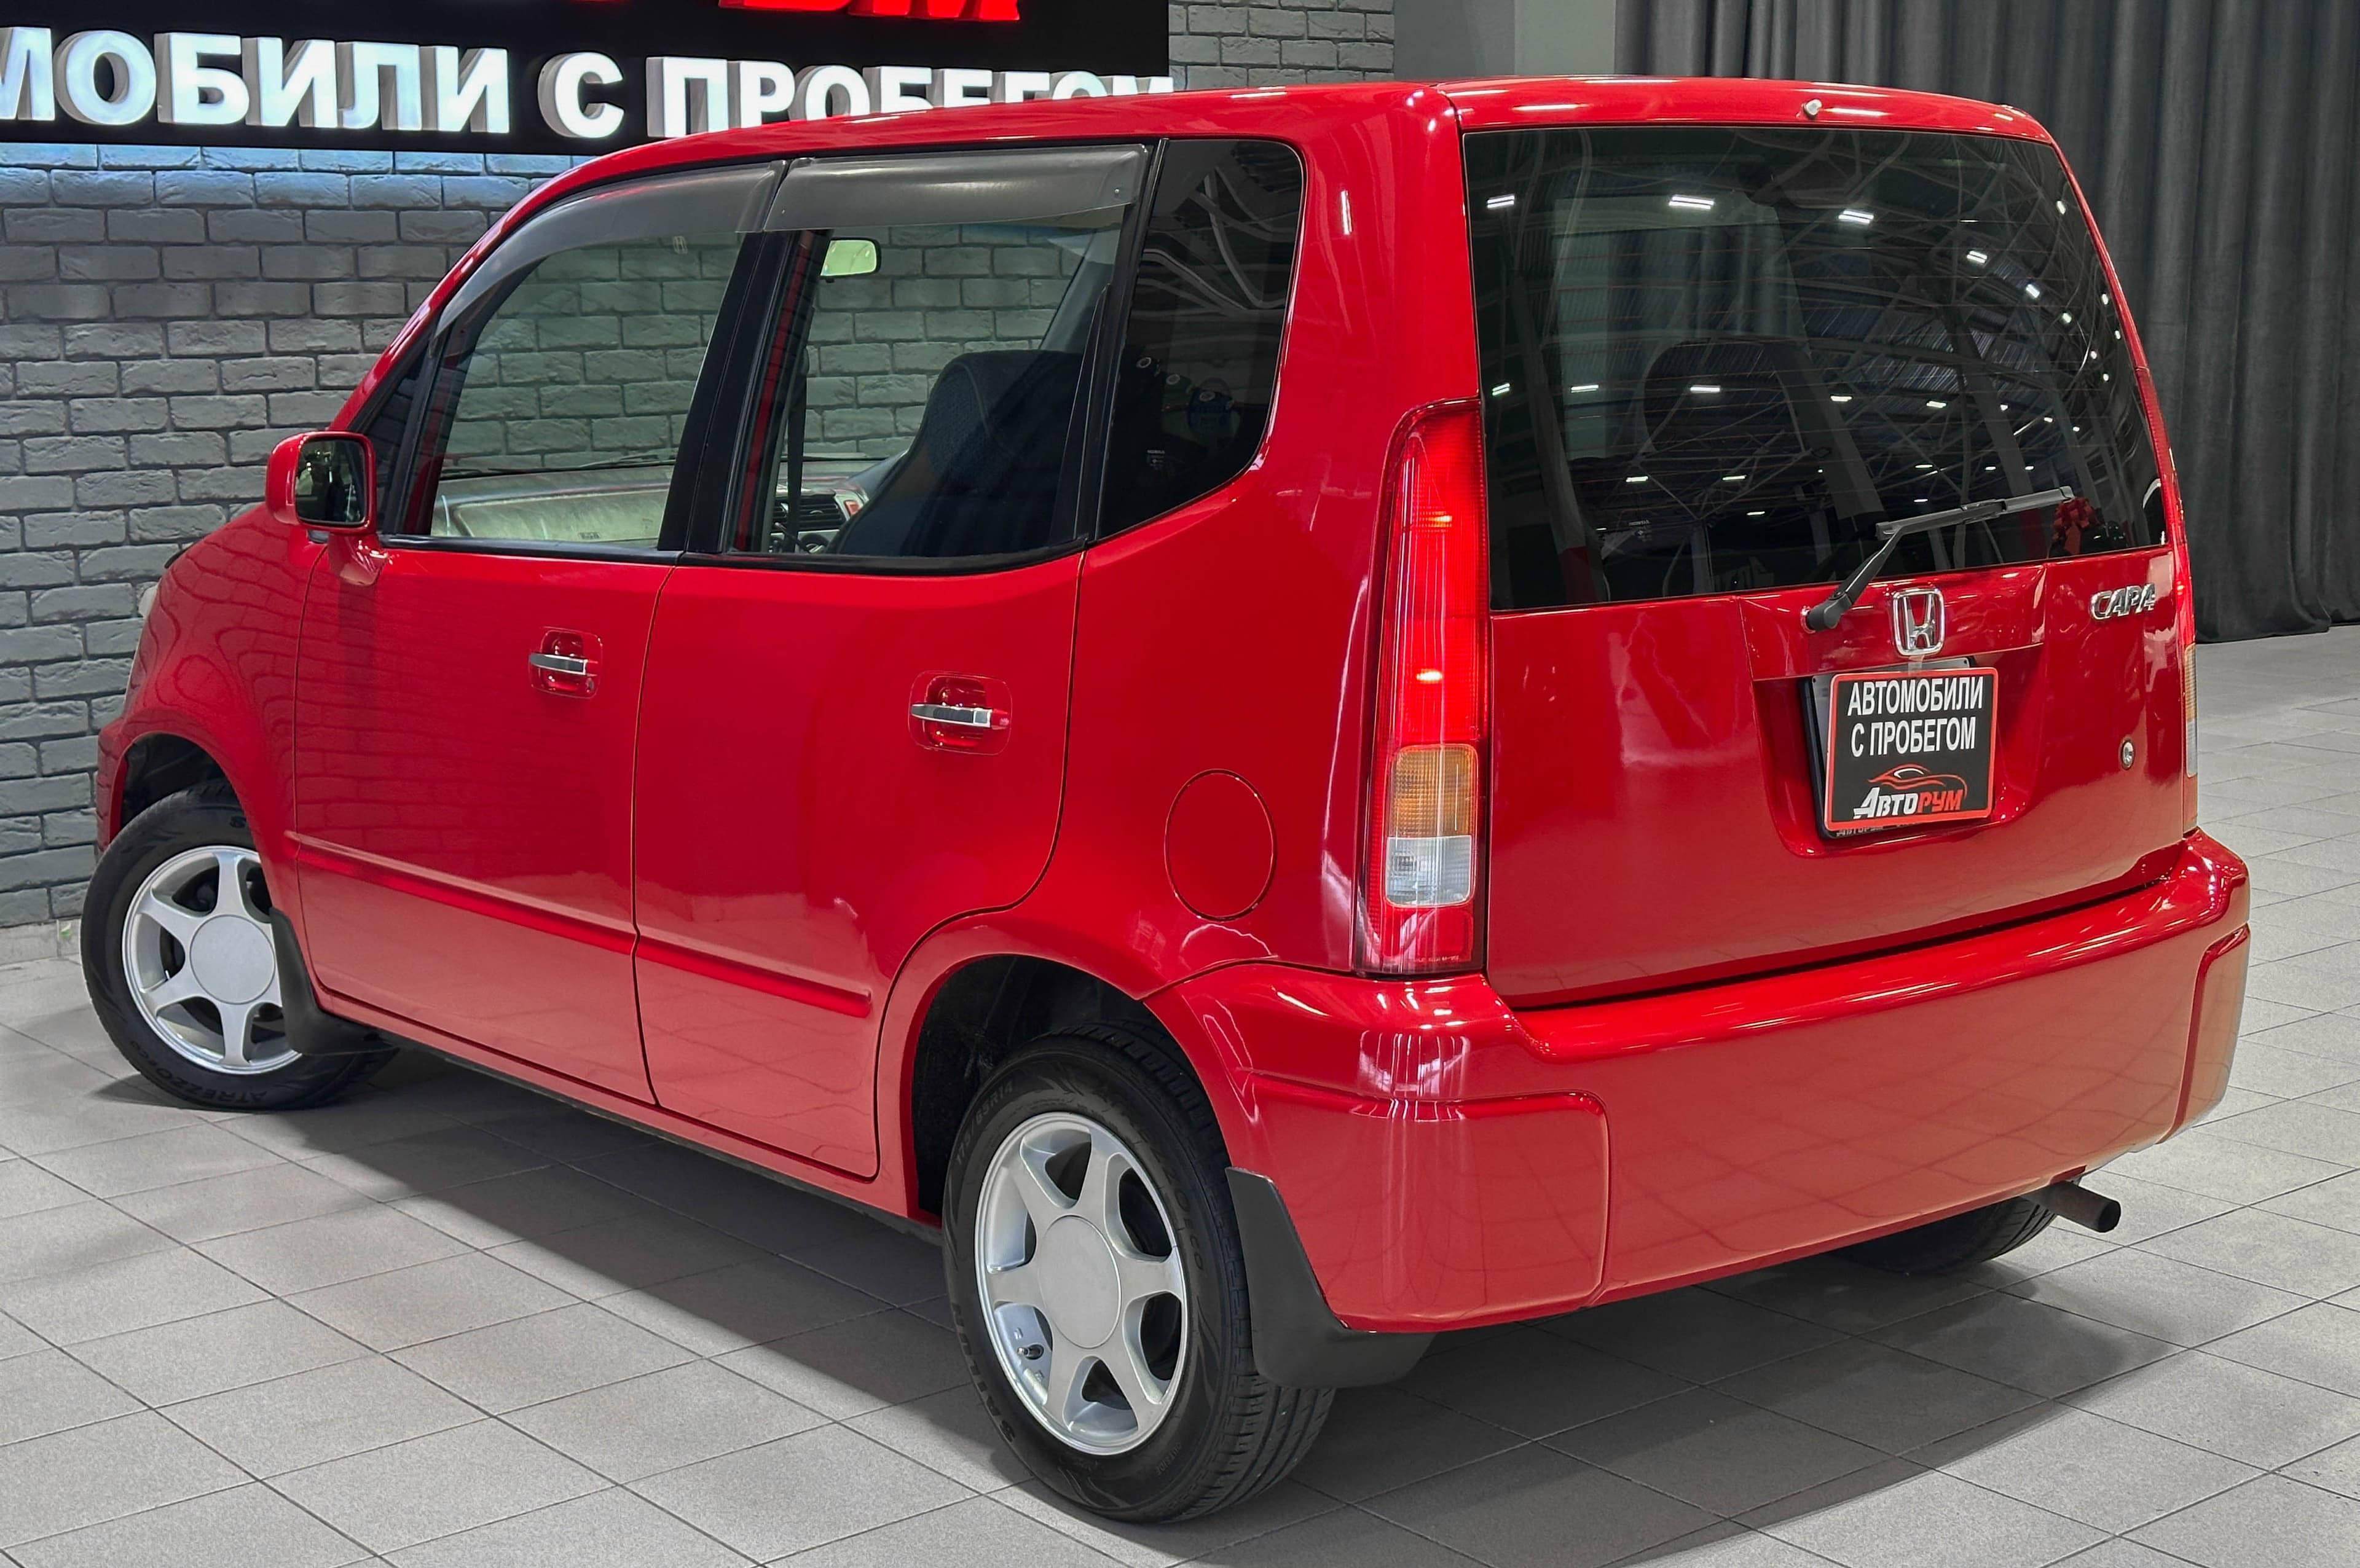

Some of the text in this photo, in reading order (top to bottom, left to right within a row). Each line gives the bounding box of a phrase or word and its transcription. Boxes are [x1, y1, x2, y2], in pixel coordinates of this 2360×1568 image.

[538, 52, 624, 138] С
[647, 56, 1173, 138] ПРОБЕ
[2091, 584, 2155, 620] CAPA
[1847, 676, 1984, 716] АВТОМОБИЛИ
[1851, 717, 1976, 757] С ПРОБЕГОМ
